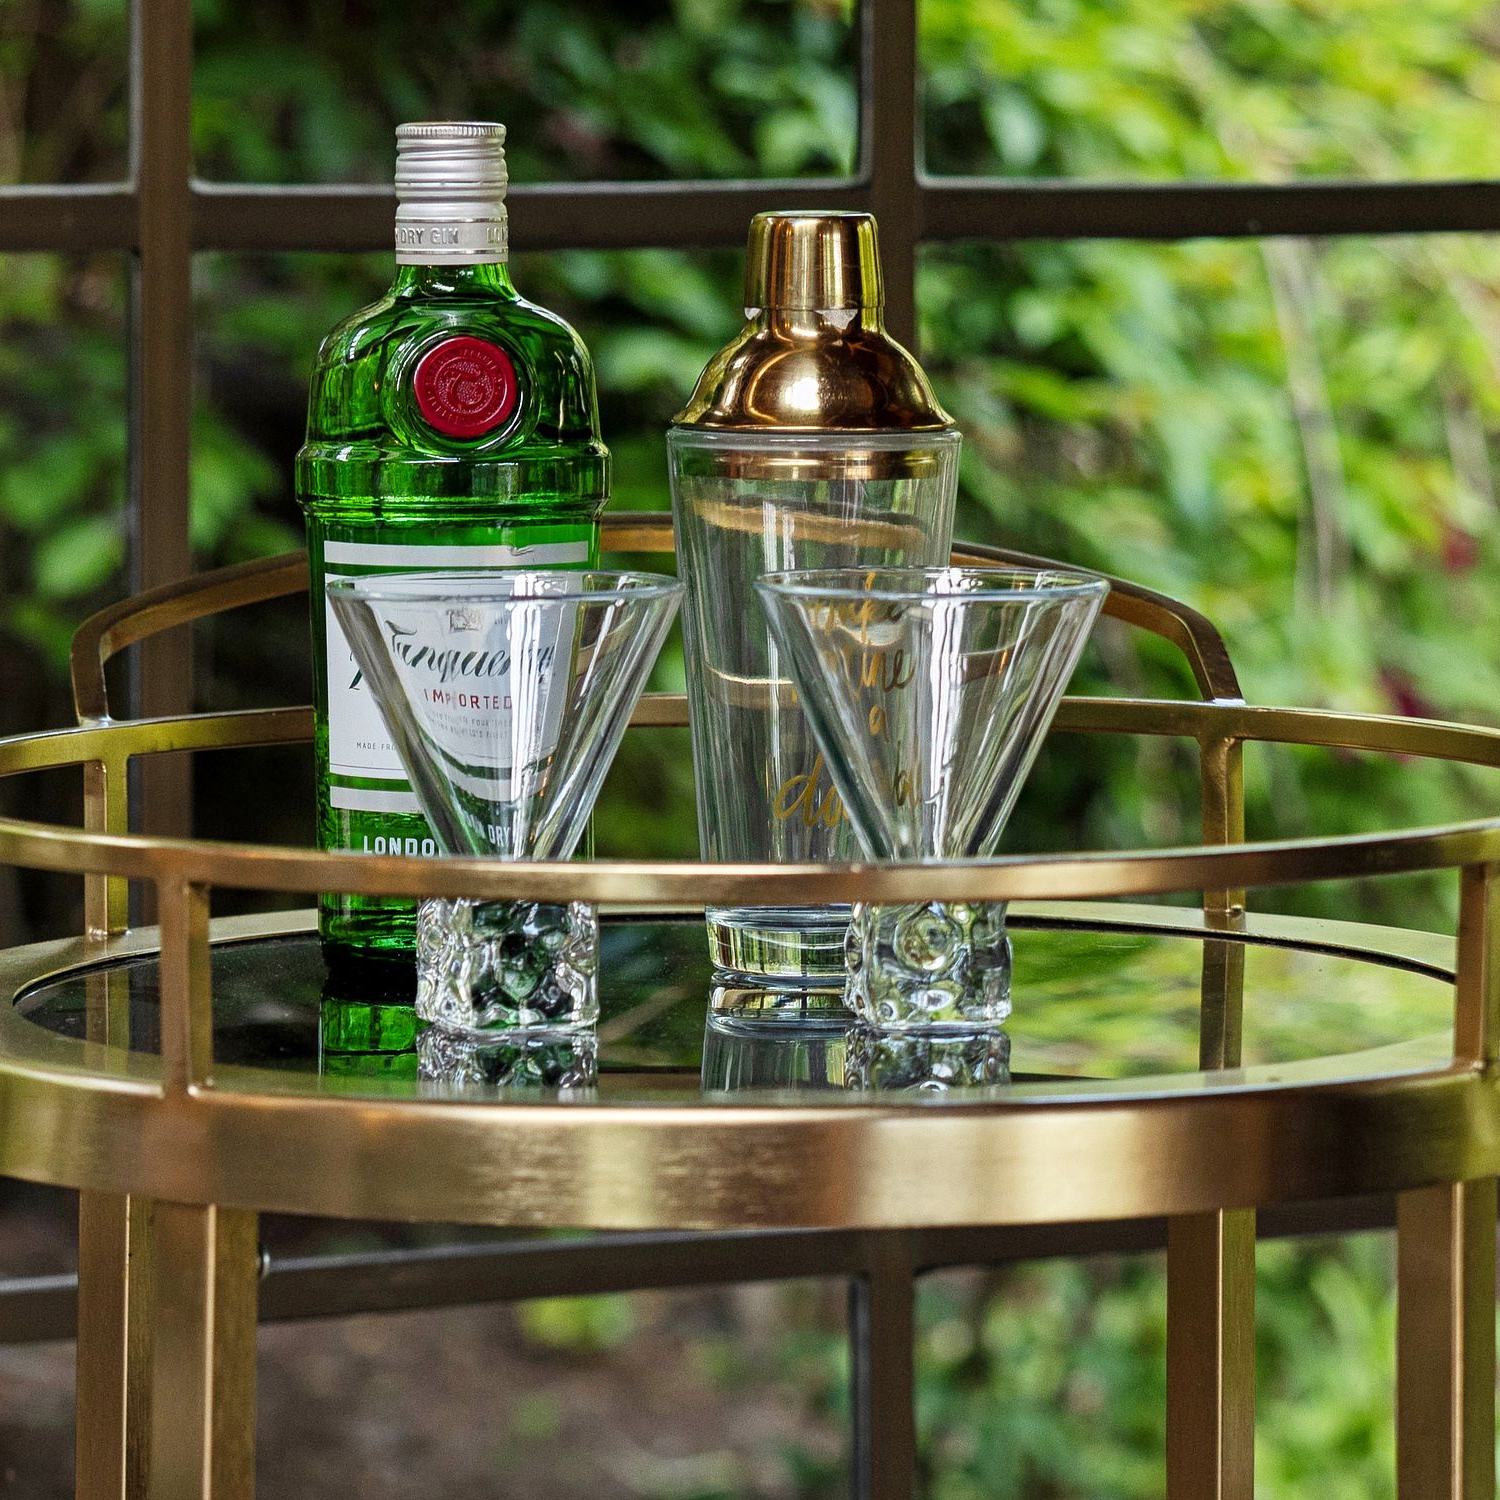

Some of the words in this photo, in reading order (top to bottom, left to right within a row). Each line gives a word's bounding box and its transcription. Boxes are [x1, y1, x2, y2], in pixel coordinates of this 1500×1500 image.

[402, 227, 425, 244] DRY
[430, 227, 458, 244] GIN
[357, 741, 376, 750] MADE
[363, 835, 443, 857] LONDO
